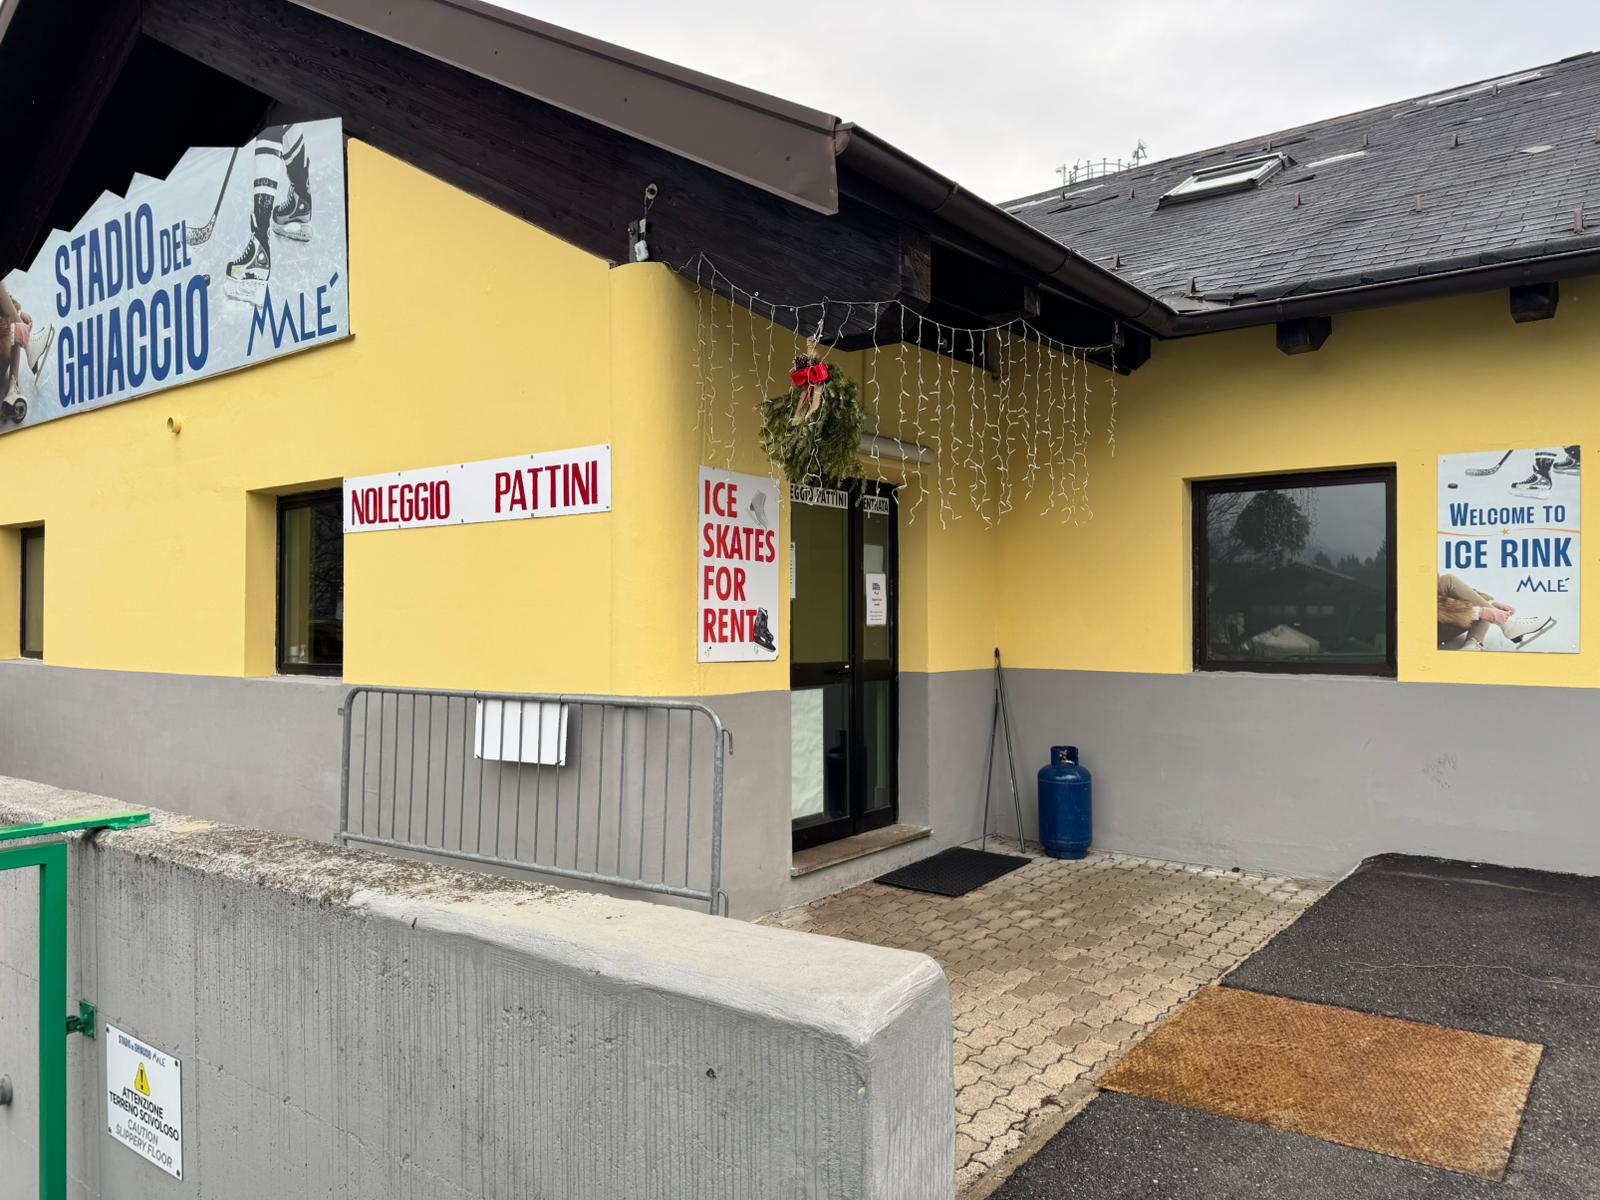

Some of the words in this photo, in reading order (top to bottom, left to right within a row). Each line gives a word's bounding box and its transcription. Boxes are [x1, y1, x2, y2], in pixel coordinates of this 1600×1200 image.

[55, 203, 153, 318] STADIO
[160, 220, 191, 276] DEL
[58, 274, 209, 408] GHIACCIO
[351, 480, 450, 525] NOLEGGIO
[495, 460, 598, 513] PATTINI
[704, 480, 738, 518] ICE
[1543, 504, 1566, 523] TO
[703, 522, 776, 563] SKATES
[1445, 540, 1488, 569] ICE
[1501, 537, 1572, 568] RINK
[703, 565, 747, 601] FOR
[703, 608, 757, 643] RENT
[109, 1091, 138, 1118] TERRENO
[140, 1110, 179, 1141] SCIVOLOSO
[122, 1086, 163, 1120] ATTENZIONE
[115, 1124, 147, 1151] SLIPPERY
[147, 1143, 173, 1168] FLOOR
[127, 1119, 158, 1145] CAUTION
